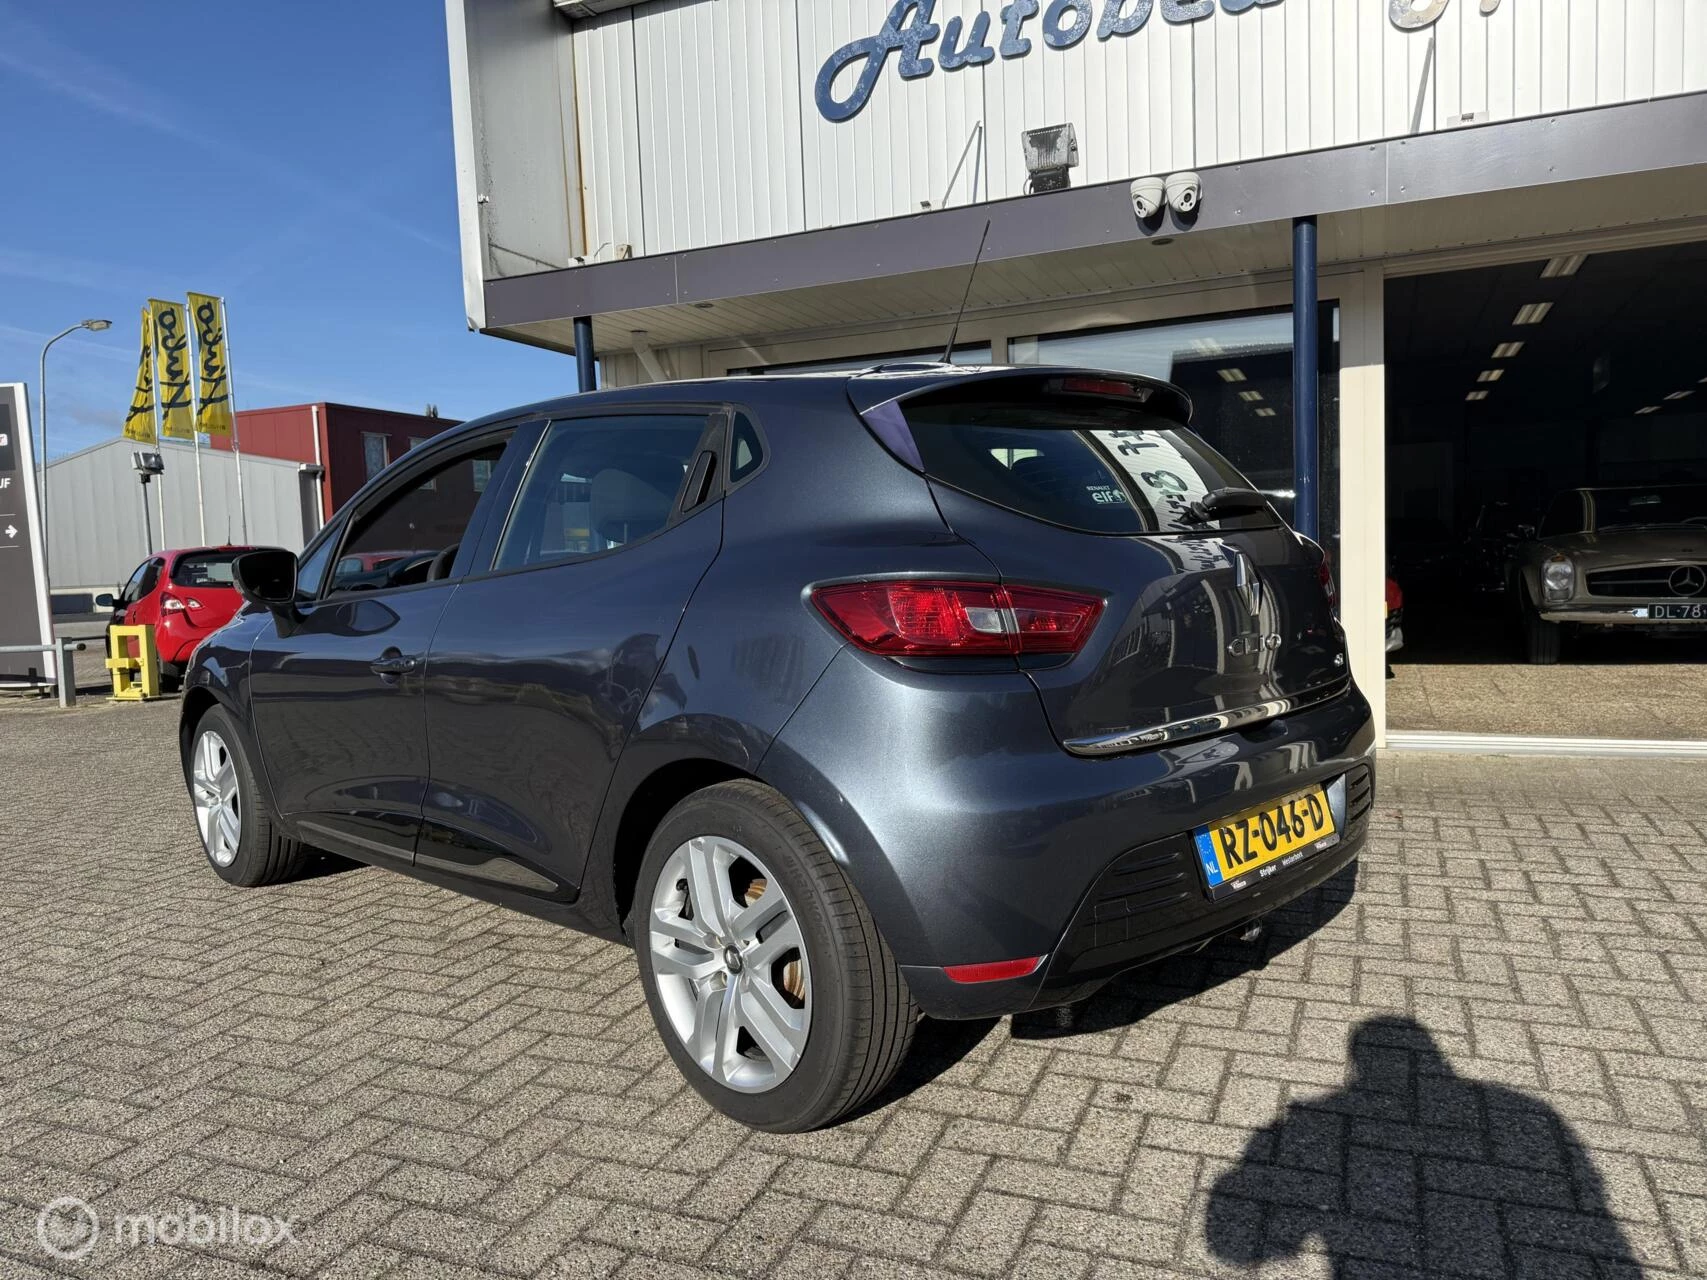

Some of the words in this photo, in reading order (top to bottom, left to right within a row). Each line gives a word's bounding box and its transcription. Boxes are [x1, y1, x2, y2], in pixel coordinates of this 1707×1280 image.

[1091, 491, 1114, 503] elf
[1227, 632, 1281, 657] CLIO
[1218, 794, 1324, 869] RZ-046-D
[1205, 861, 1219, 876] NL
